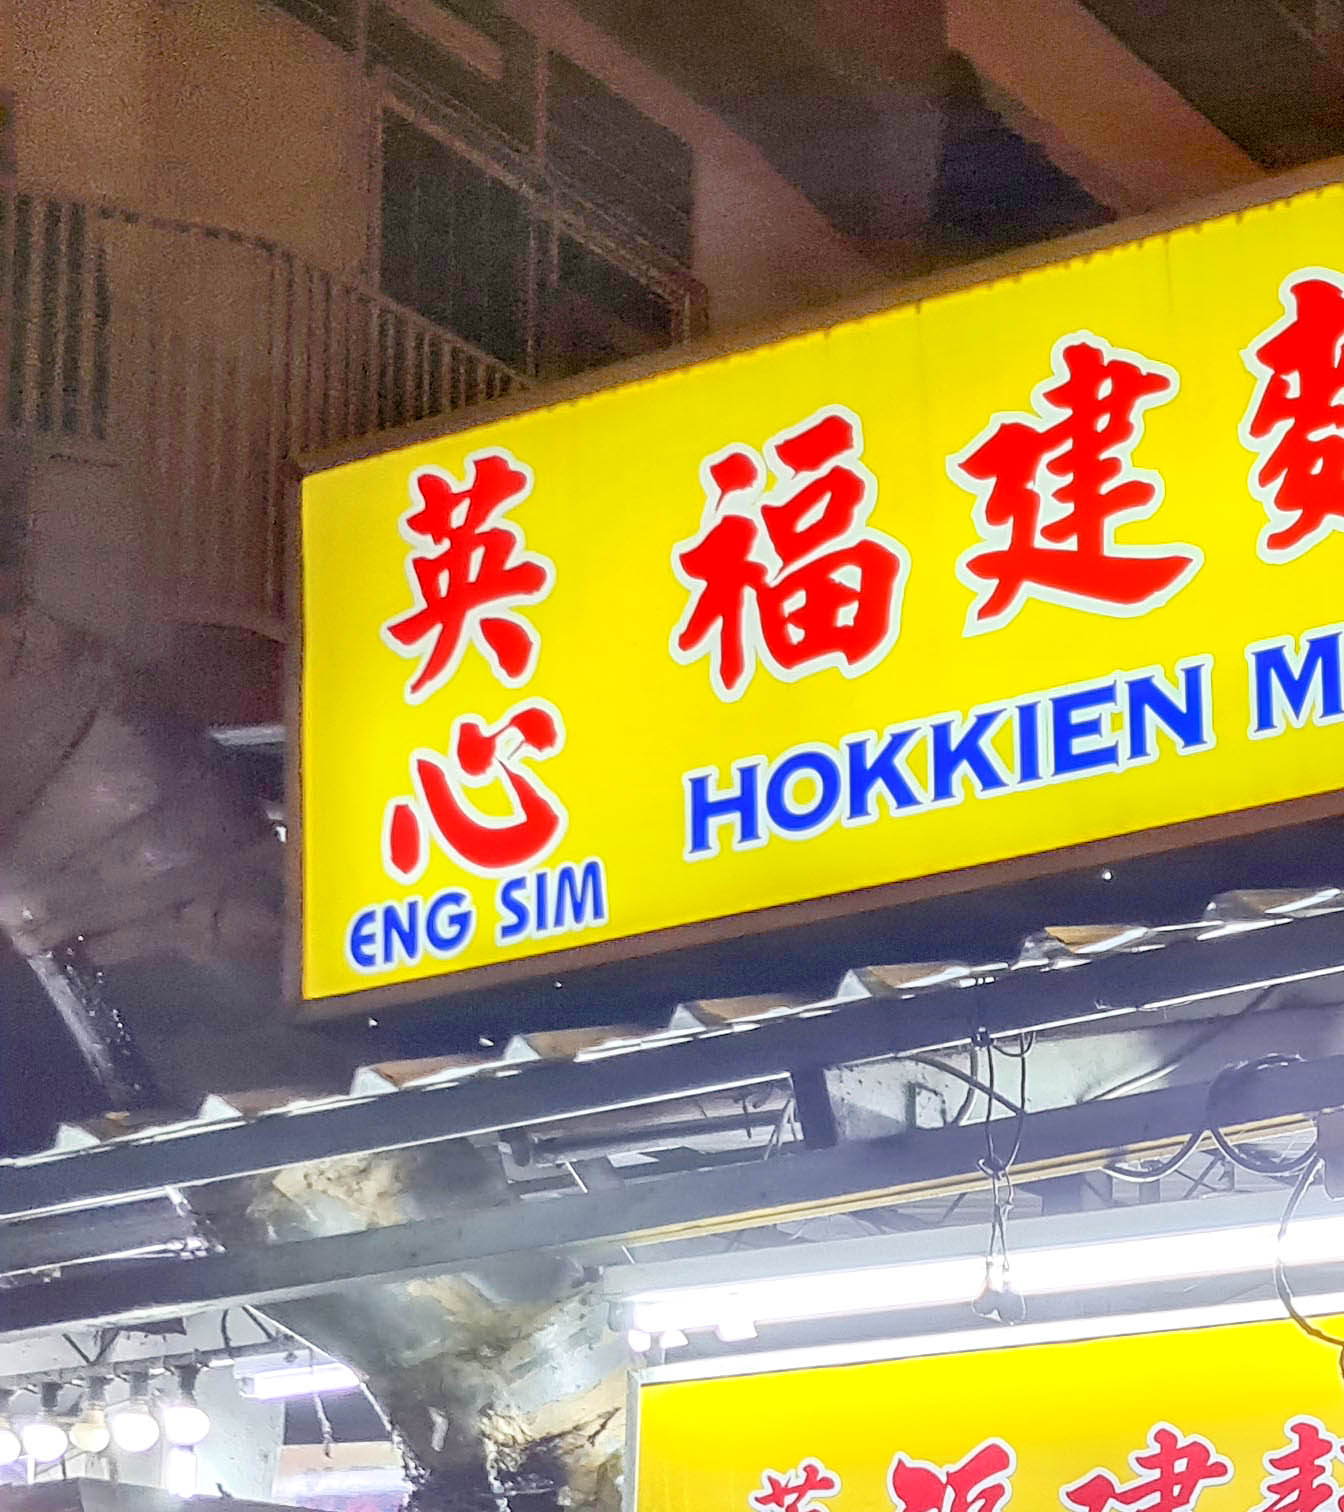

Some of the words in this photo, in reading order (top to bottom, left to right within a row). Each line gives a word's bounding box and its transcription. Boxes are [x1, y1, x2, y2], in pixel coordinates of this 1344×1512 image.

[386, 453, 562, 876] 英心
[687, 664, 1208, 856] HOKKIEN
[348, 890, 472, 970] ENG
[500, 860, 605, 939] SIM
